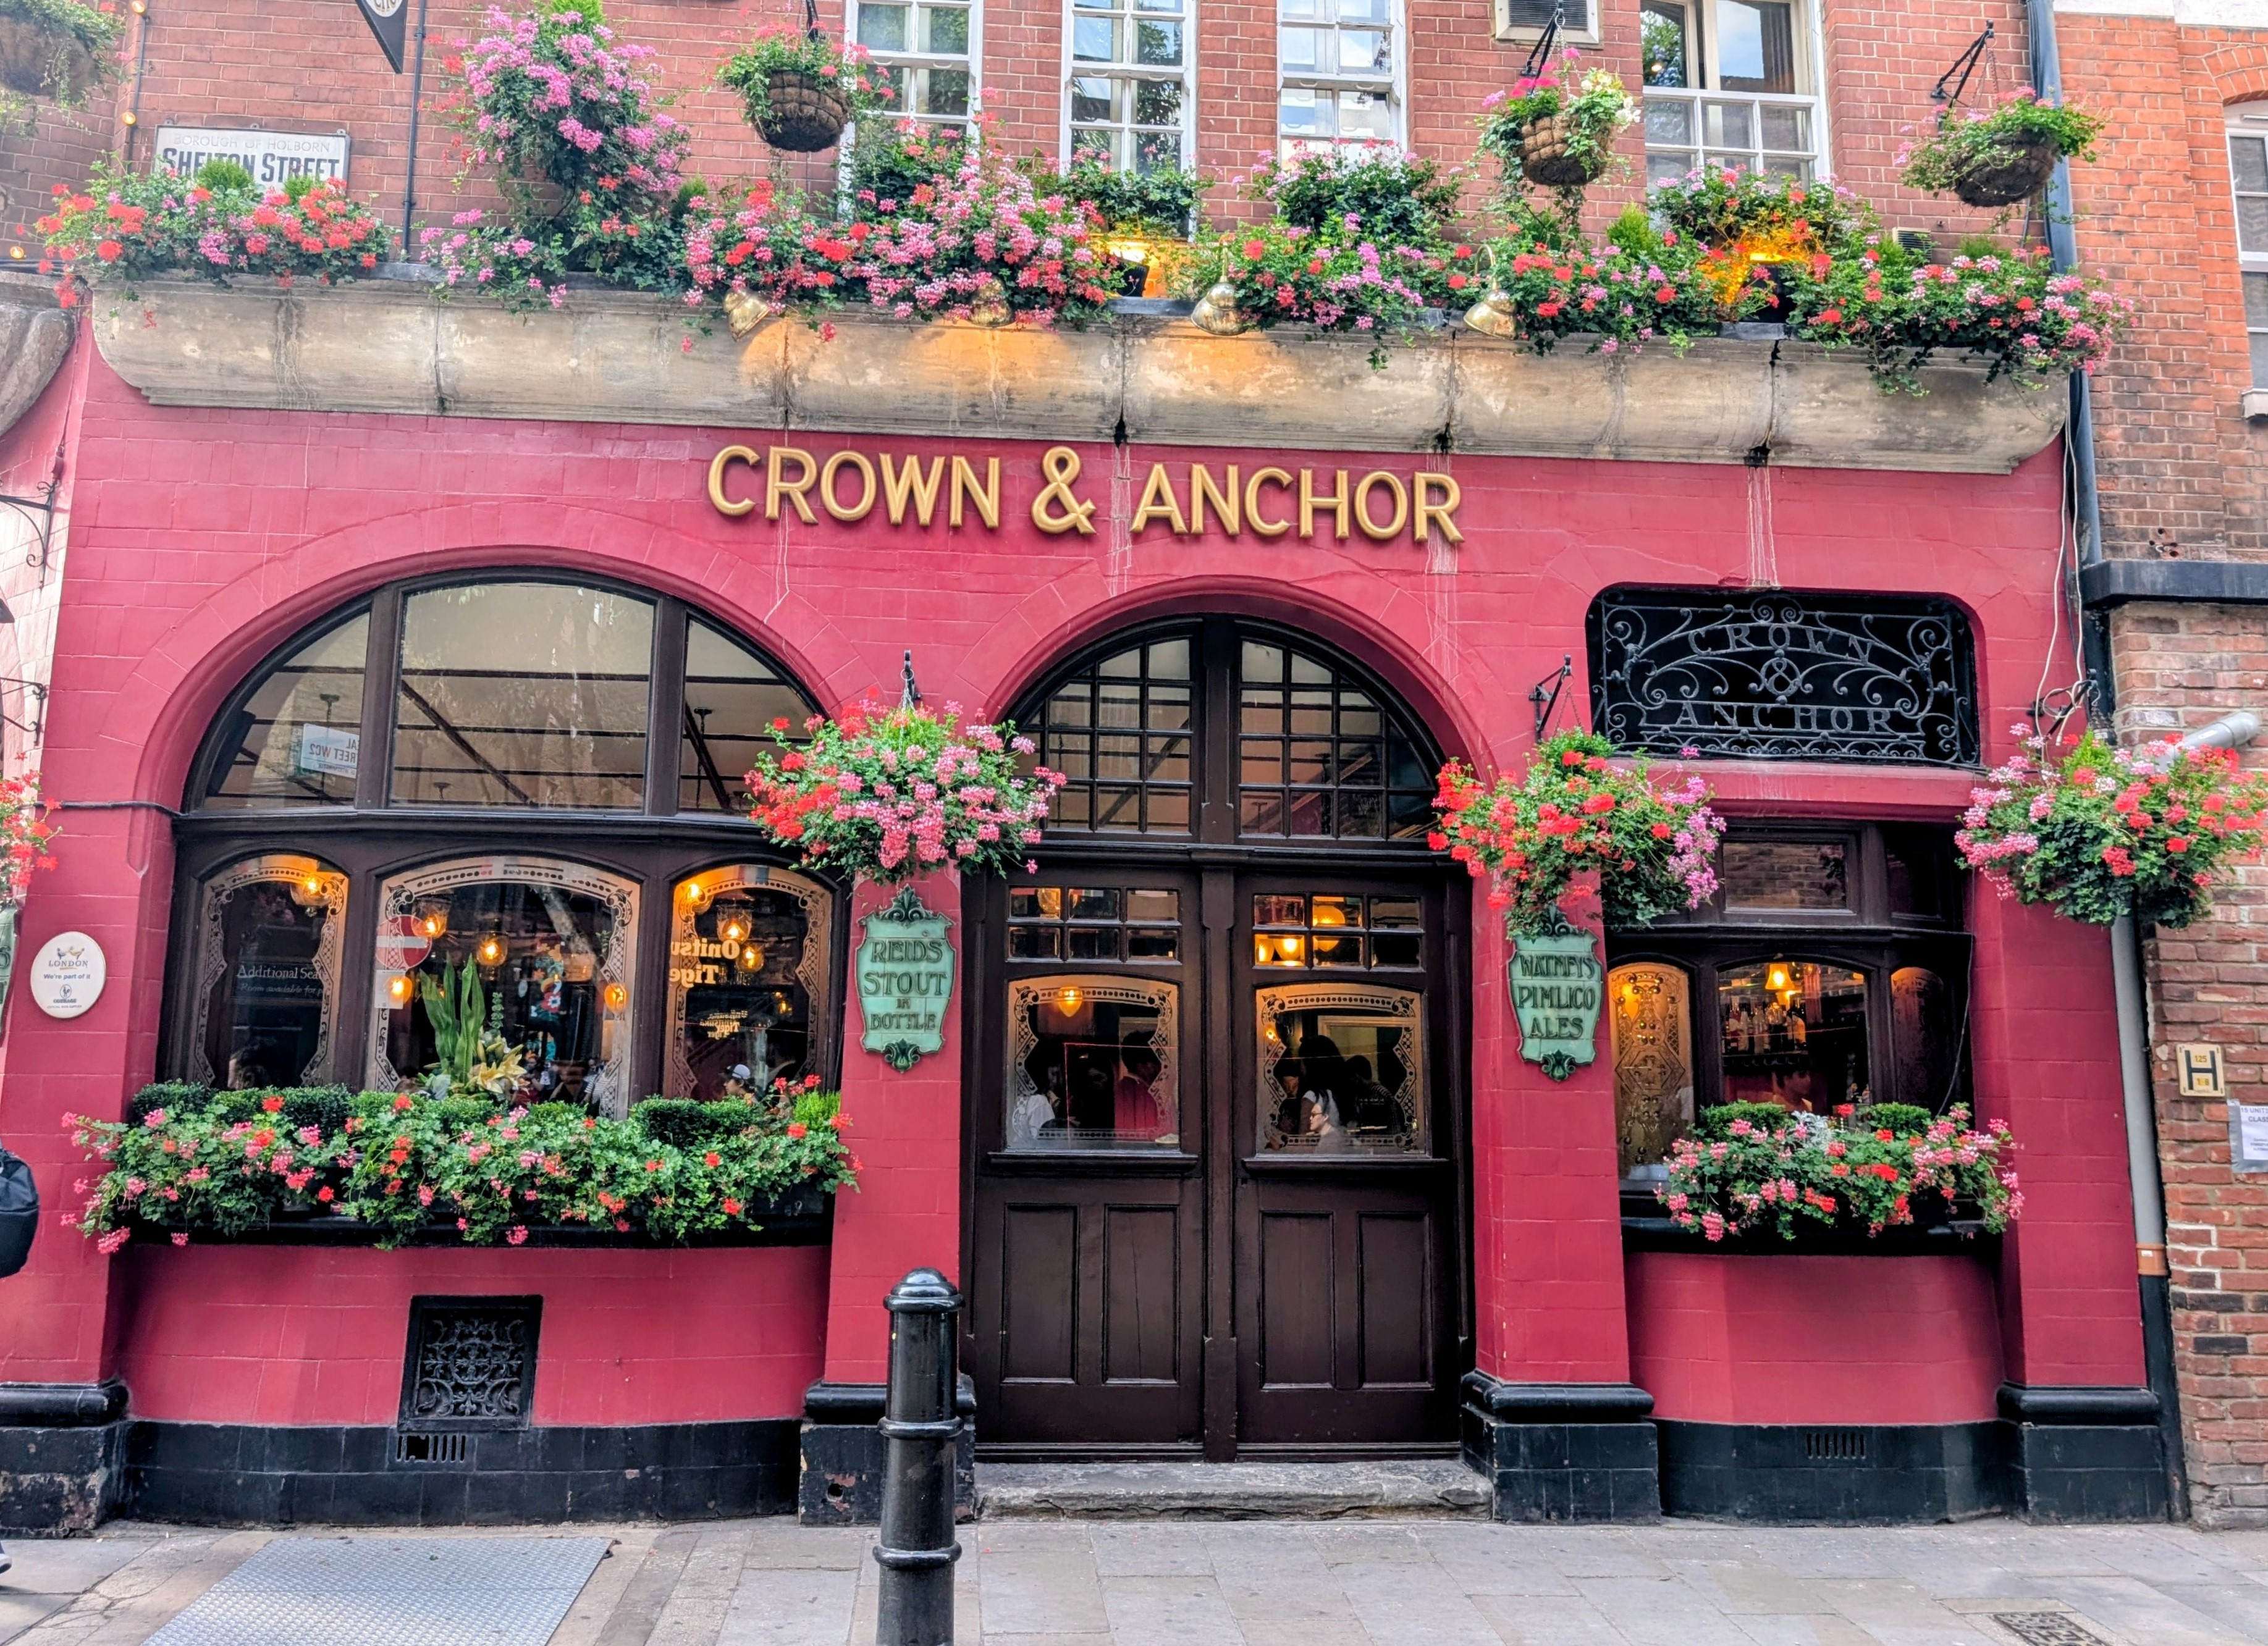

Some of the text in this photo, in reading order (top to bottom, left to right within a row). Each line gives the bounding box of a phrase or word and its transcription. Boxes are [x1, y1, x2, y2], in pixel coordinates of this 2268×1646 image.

[174, 133, 330, 153] BOROUGH OF HOLBORN
[162, 148, 340, 183] SHEN STREET
[708, 445, 1465, 542] CROWN & ANCHOR
[1688, 623, 1875, 665] CROWN
[1764, 657, 1802, 697] &
[1676, 700, 1898, 736] ANCHOR
[870, 940, 943, 964] REIDS
[48, 960, 88, 968] LONDON
[237, 965, 298, 979] Additional
[1518, 955, 1595, 978] WATNEYS
[240, 983, 264, 992] Room
[266, 985, 301, 994] available
[304, 985, 316, 996] for
[864, 971, 948, 996] STOUT
[896, 998, 911, 1009] IN
[1517, 986, 1596, 1010] PIMLICO
[870, 1013, 936, 1030] BOTTLE
[1528, 1016, 1583, 1039] ALES
[2185, 1050, 2219, 1091] H
[2194, 1055, 2207, 1063] 125
